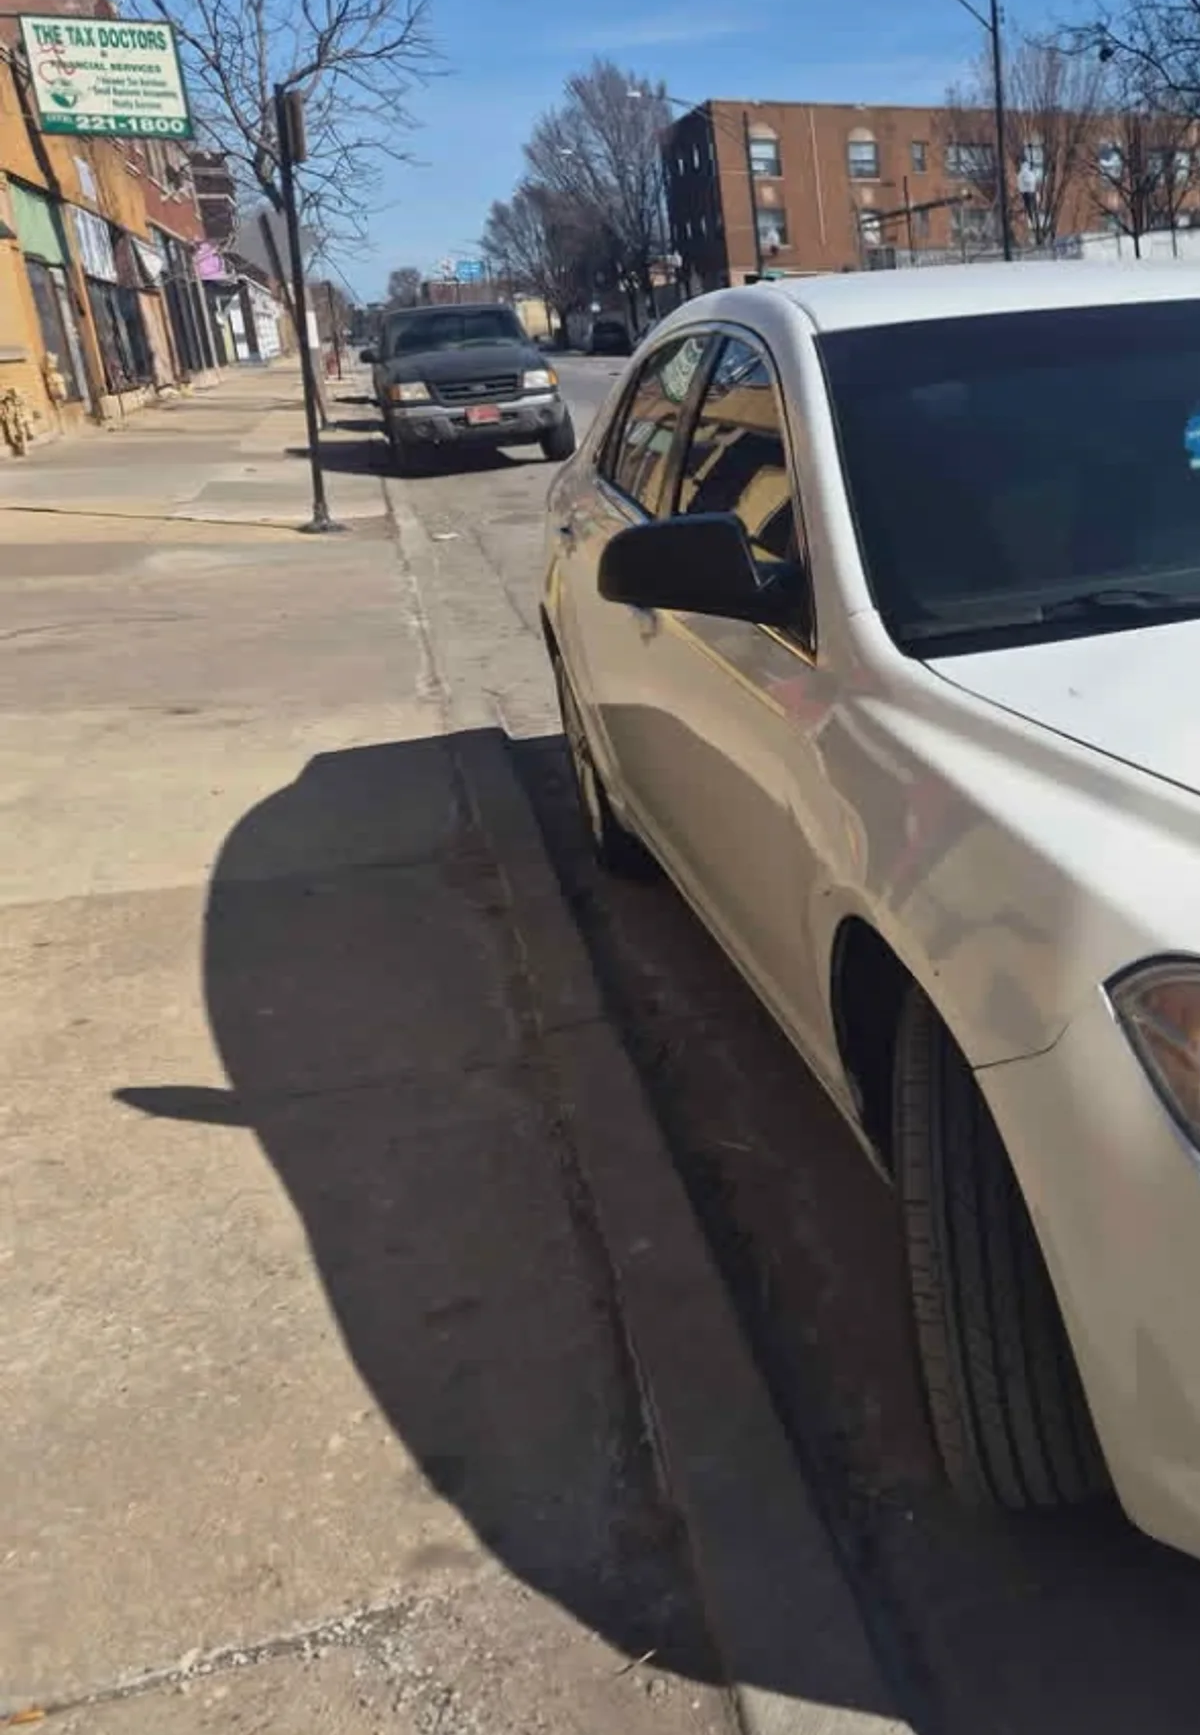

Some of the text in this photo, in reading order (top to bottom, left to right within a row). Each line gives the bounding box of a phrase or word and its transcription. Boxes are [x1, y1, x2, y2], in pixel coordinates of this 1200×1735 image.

[32, 24, 167, 51] THE TAX DOCTORS
[110, 62, 162, 74] SERVICES
[75, 115, 185, 133] 221-1800
